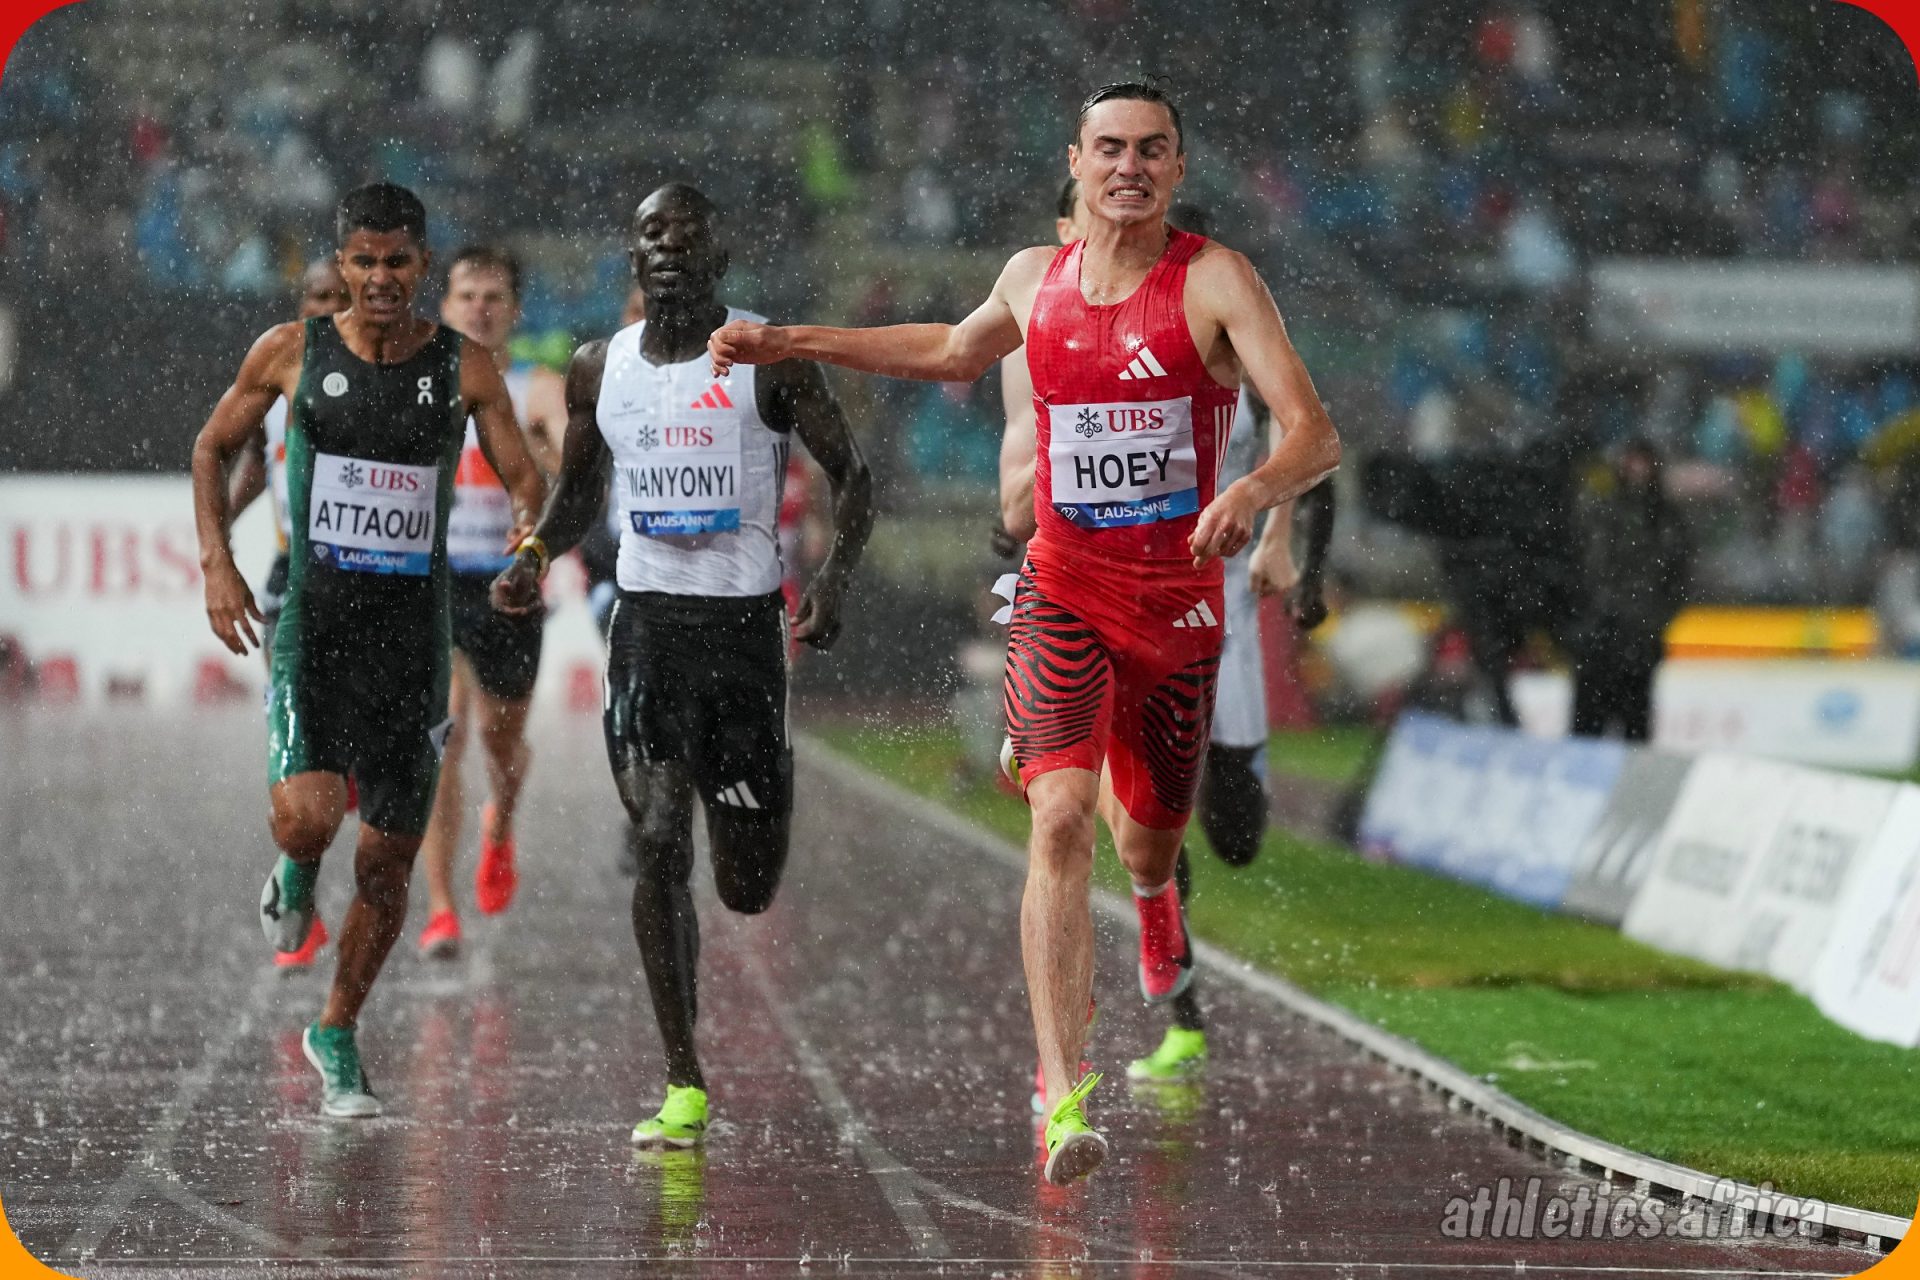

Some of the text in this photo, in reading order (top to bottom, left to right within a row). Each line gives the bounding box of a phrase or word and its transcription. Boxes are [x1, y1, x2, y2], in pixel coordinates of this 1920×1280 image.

[1106, 408, 1164, 433] UBS
[664, 426, 713, 447] UBS
[369, 467, 419, 492] UBS
[626, 465, 734, 497] WANYONYI
[1074, 449, 1171, 489] HOEY
[315, 499, 430, 540] ATTAOUI
[647, 515, 714, 527] LAUSANNE
[1095, 499, 1171, 520] LAUSANNE
